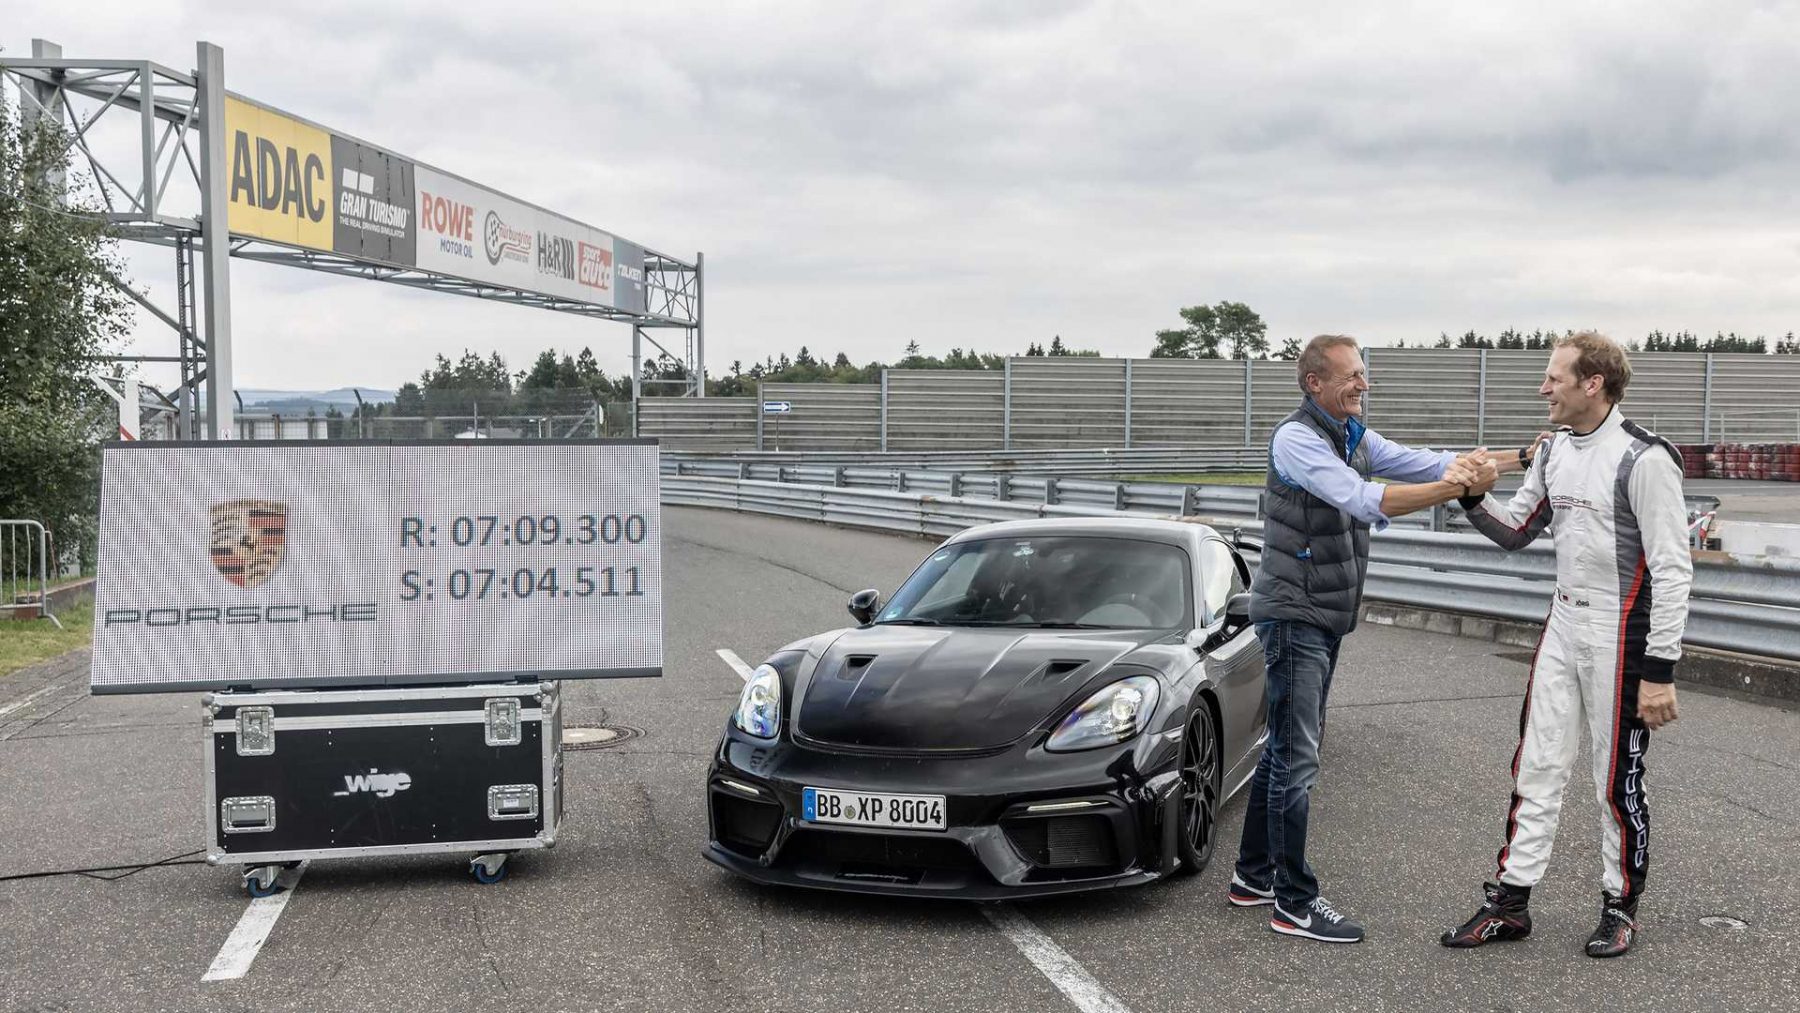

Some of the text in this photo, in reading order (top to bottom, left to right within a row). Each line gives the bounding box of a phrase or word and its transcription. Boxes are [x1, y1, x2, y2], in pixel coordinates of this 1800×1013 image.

[231, 130, 326, 223] ADAC
[340, 191, 368, 219] GRAN
[420, 190, 473, 242] ROWE
[340, 215, 405, 239] THE REAL DRIVING SIMULATOR
[440, 239, 473, 259] MOTOR OIL
[584, 245, 601, 263] sport
[581, 257, 611, 288] auto
[1551, 495, 1592, 507] PORSCHE
[400, 514, 646, 547] R: 07:09.300
[400, 567, 645, 601] S: 07:04.511
[104, 603, 378, 628] PORSCHE
[817, 794, 942, 825] BB XP 8004
[1625, 729, 1648, 869] PORSCHE
